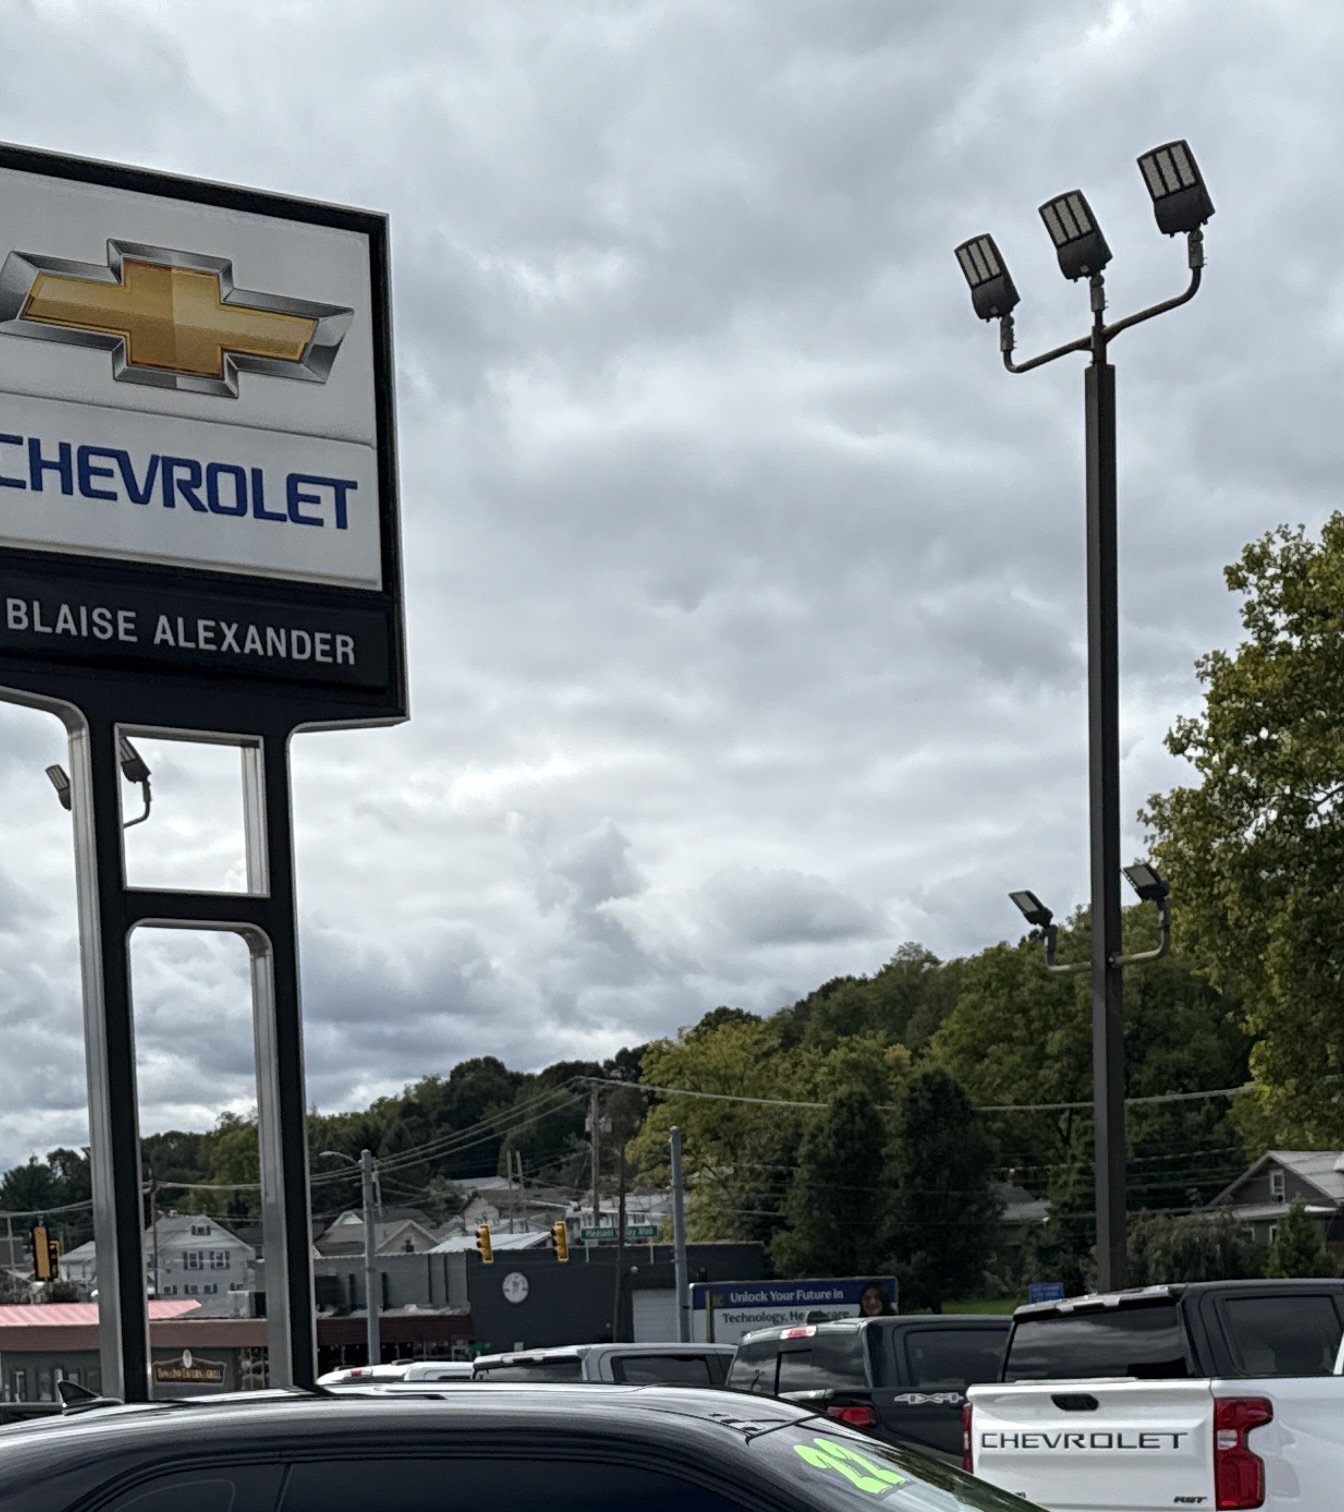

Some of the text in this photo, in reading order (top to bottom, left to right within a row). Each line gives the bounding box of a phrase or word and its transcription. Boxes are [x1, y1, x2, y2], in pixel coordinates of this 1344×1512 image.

[6, 598, 356, 665] BLAISE ALEXANDER
[730, 1287, 844, 1303] Unlock Your Future in
[981, 1432, 1188, 1449] CHEVROLET
